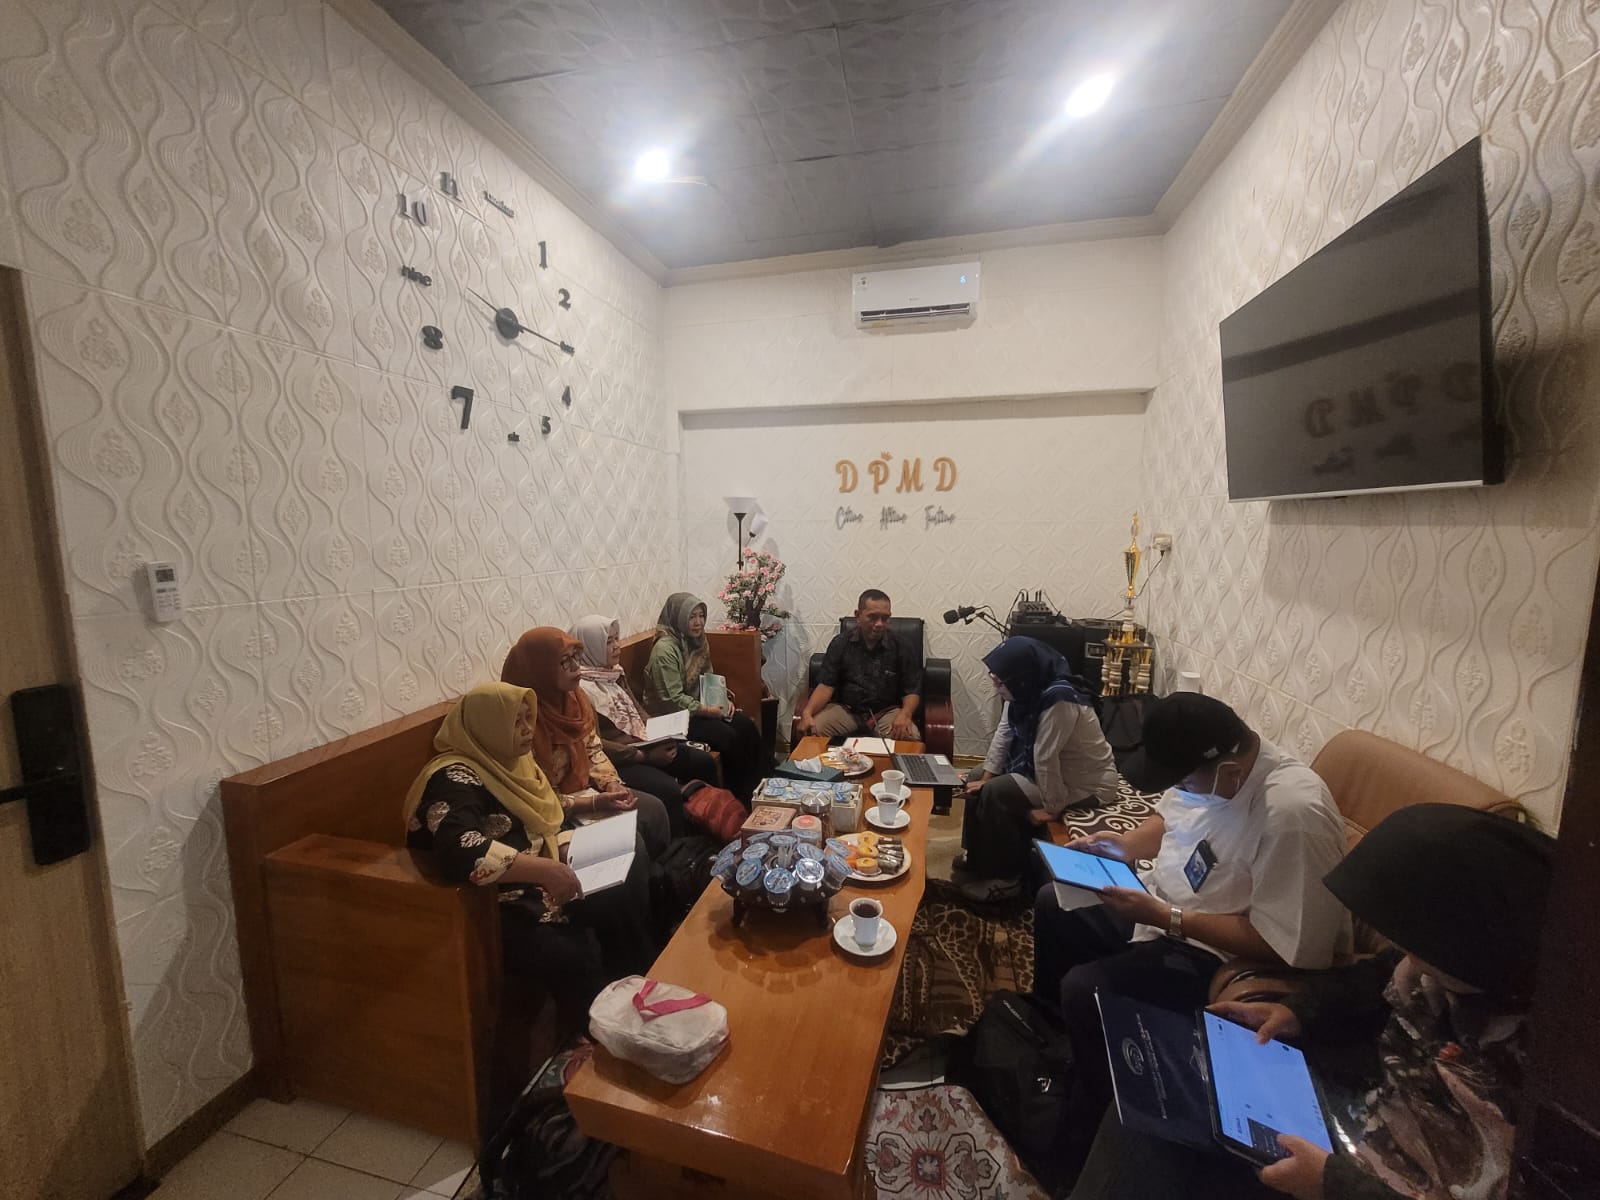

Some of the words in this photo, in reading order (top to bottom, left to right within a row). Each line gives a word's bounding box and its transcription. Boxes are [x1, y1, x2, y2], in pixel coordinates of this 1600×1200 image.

[538, 241, 548, 270] 1
[559, 288, 571, 311] 2
[422, 325, 443, 350] 8
[451, 385, 474, 430] 7
